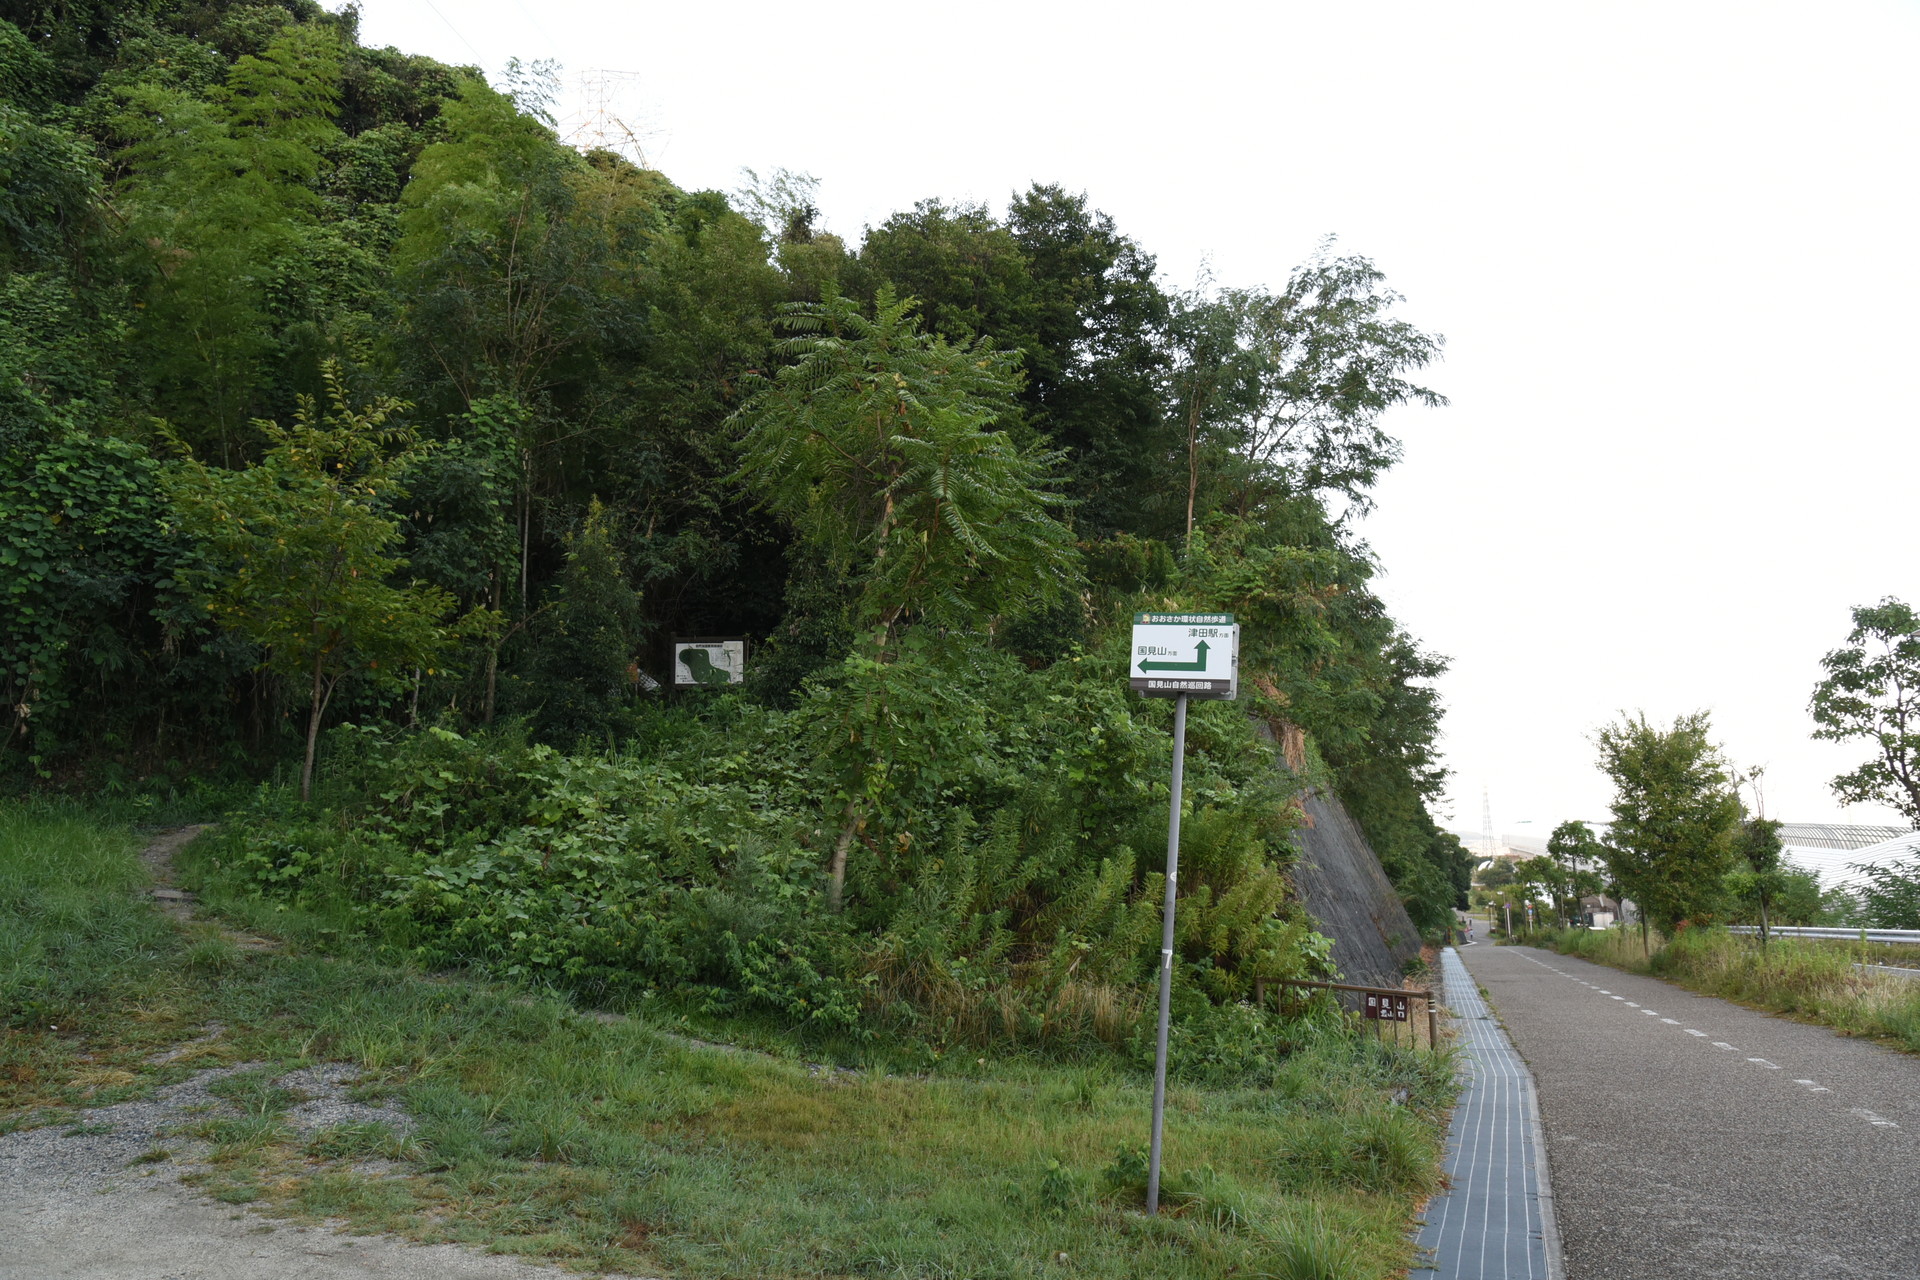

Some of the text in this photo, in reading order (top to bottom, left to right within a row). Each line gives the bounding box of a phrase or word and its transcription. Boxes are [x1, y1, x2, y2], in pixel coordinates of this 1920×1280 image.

[1151, 615, 1226, 624] おおさか環状自然歩道
[1148, 680, 1212, 689] 国見山自然巡回路
